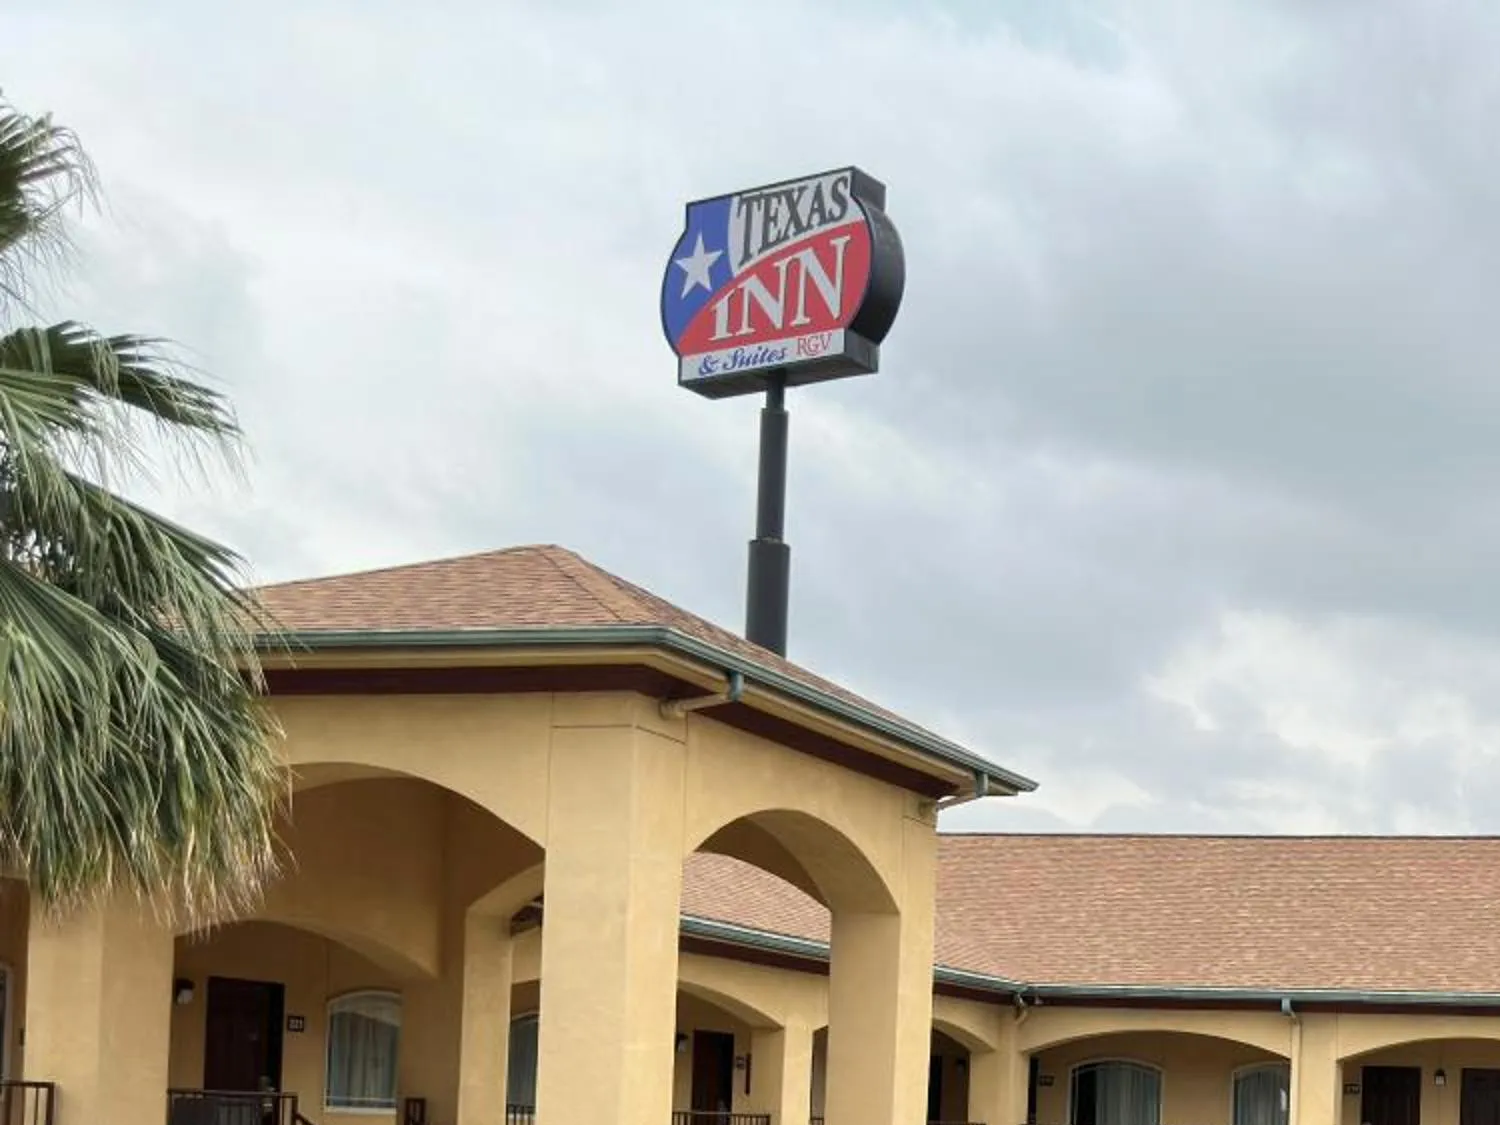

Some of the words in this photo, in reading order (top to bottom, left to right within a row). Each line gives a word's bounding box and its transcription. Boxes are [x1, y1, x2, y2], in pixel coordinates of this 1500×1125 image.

[736, 176, 849, 267] TEXAS
[708, 234, 851, 341] INN
[698, 356, 719, 377] &
[722, 343, 789, 371] Suites
[795, 333, 833, 357] RGV
